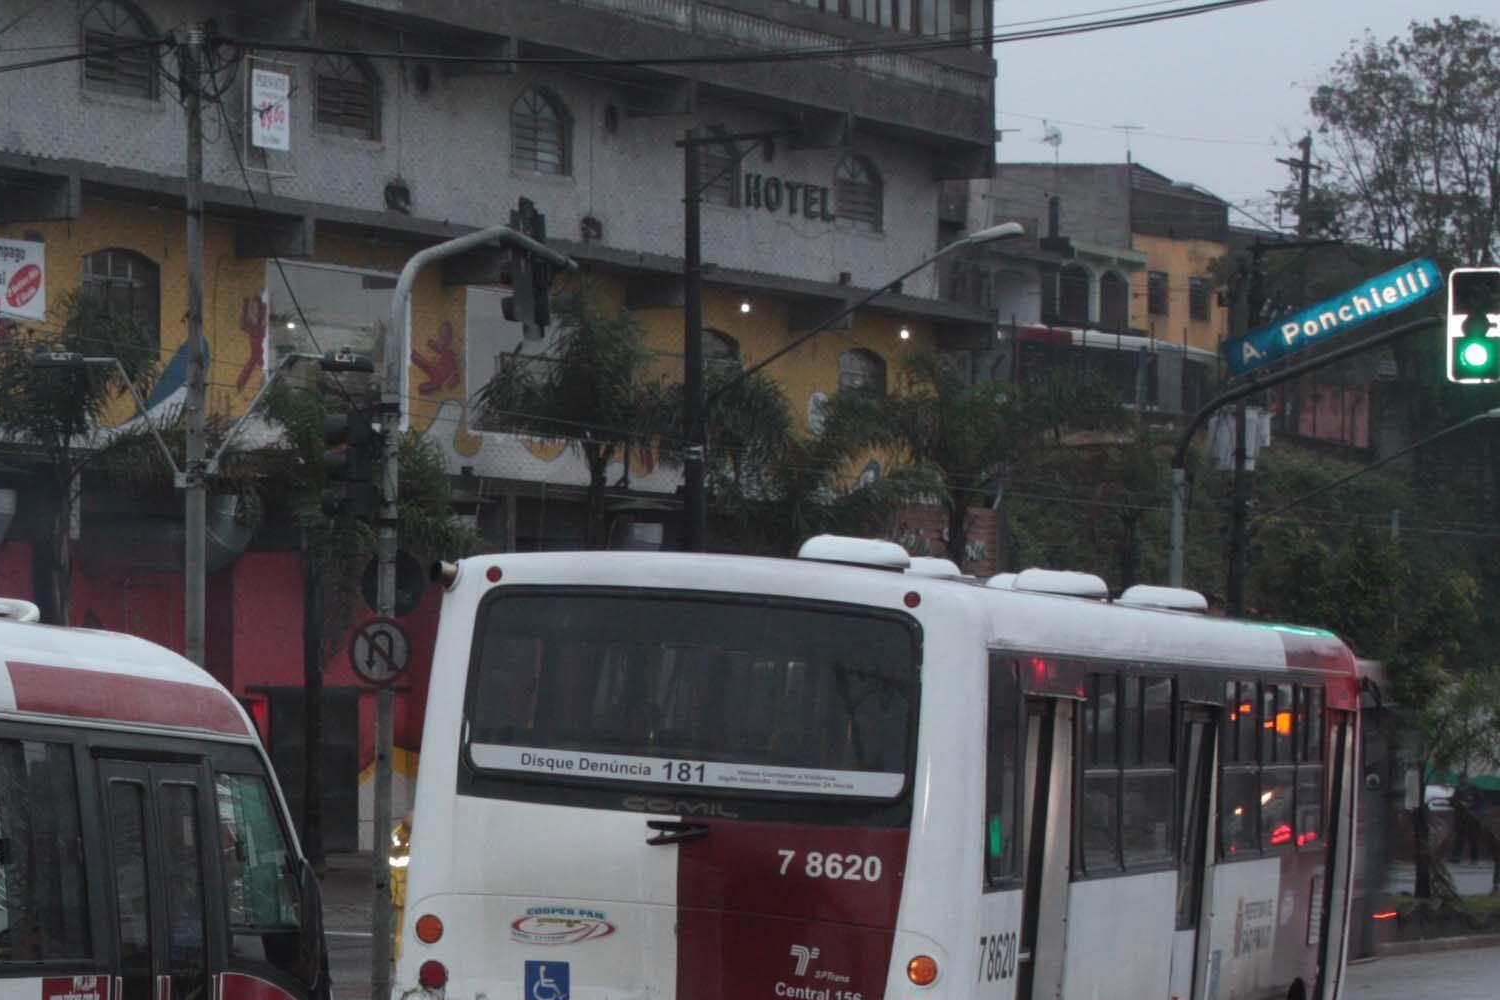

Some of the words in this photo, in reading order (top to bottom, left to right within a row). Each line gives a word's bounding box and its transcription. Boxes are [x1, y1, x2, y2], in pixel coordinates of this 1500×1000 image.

[745, 173, 835, 222] HOTEL
[1280, 267, 1431, 345] Ponchielli
[520, 753, 574, 770] Disque
[579, 757, 651, 776] Denúncia
[662, 761, 706, 783] 181
[777, 849, 796, 876] 7
[804, 851, 882, 882] 8620
[978, 936, 987, 984] 7
[987, 931, 1016, 982] 8620
